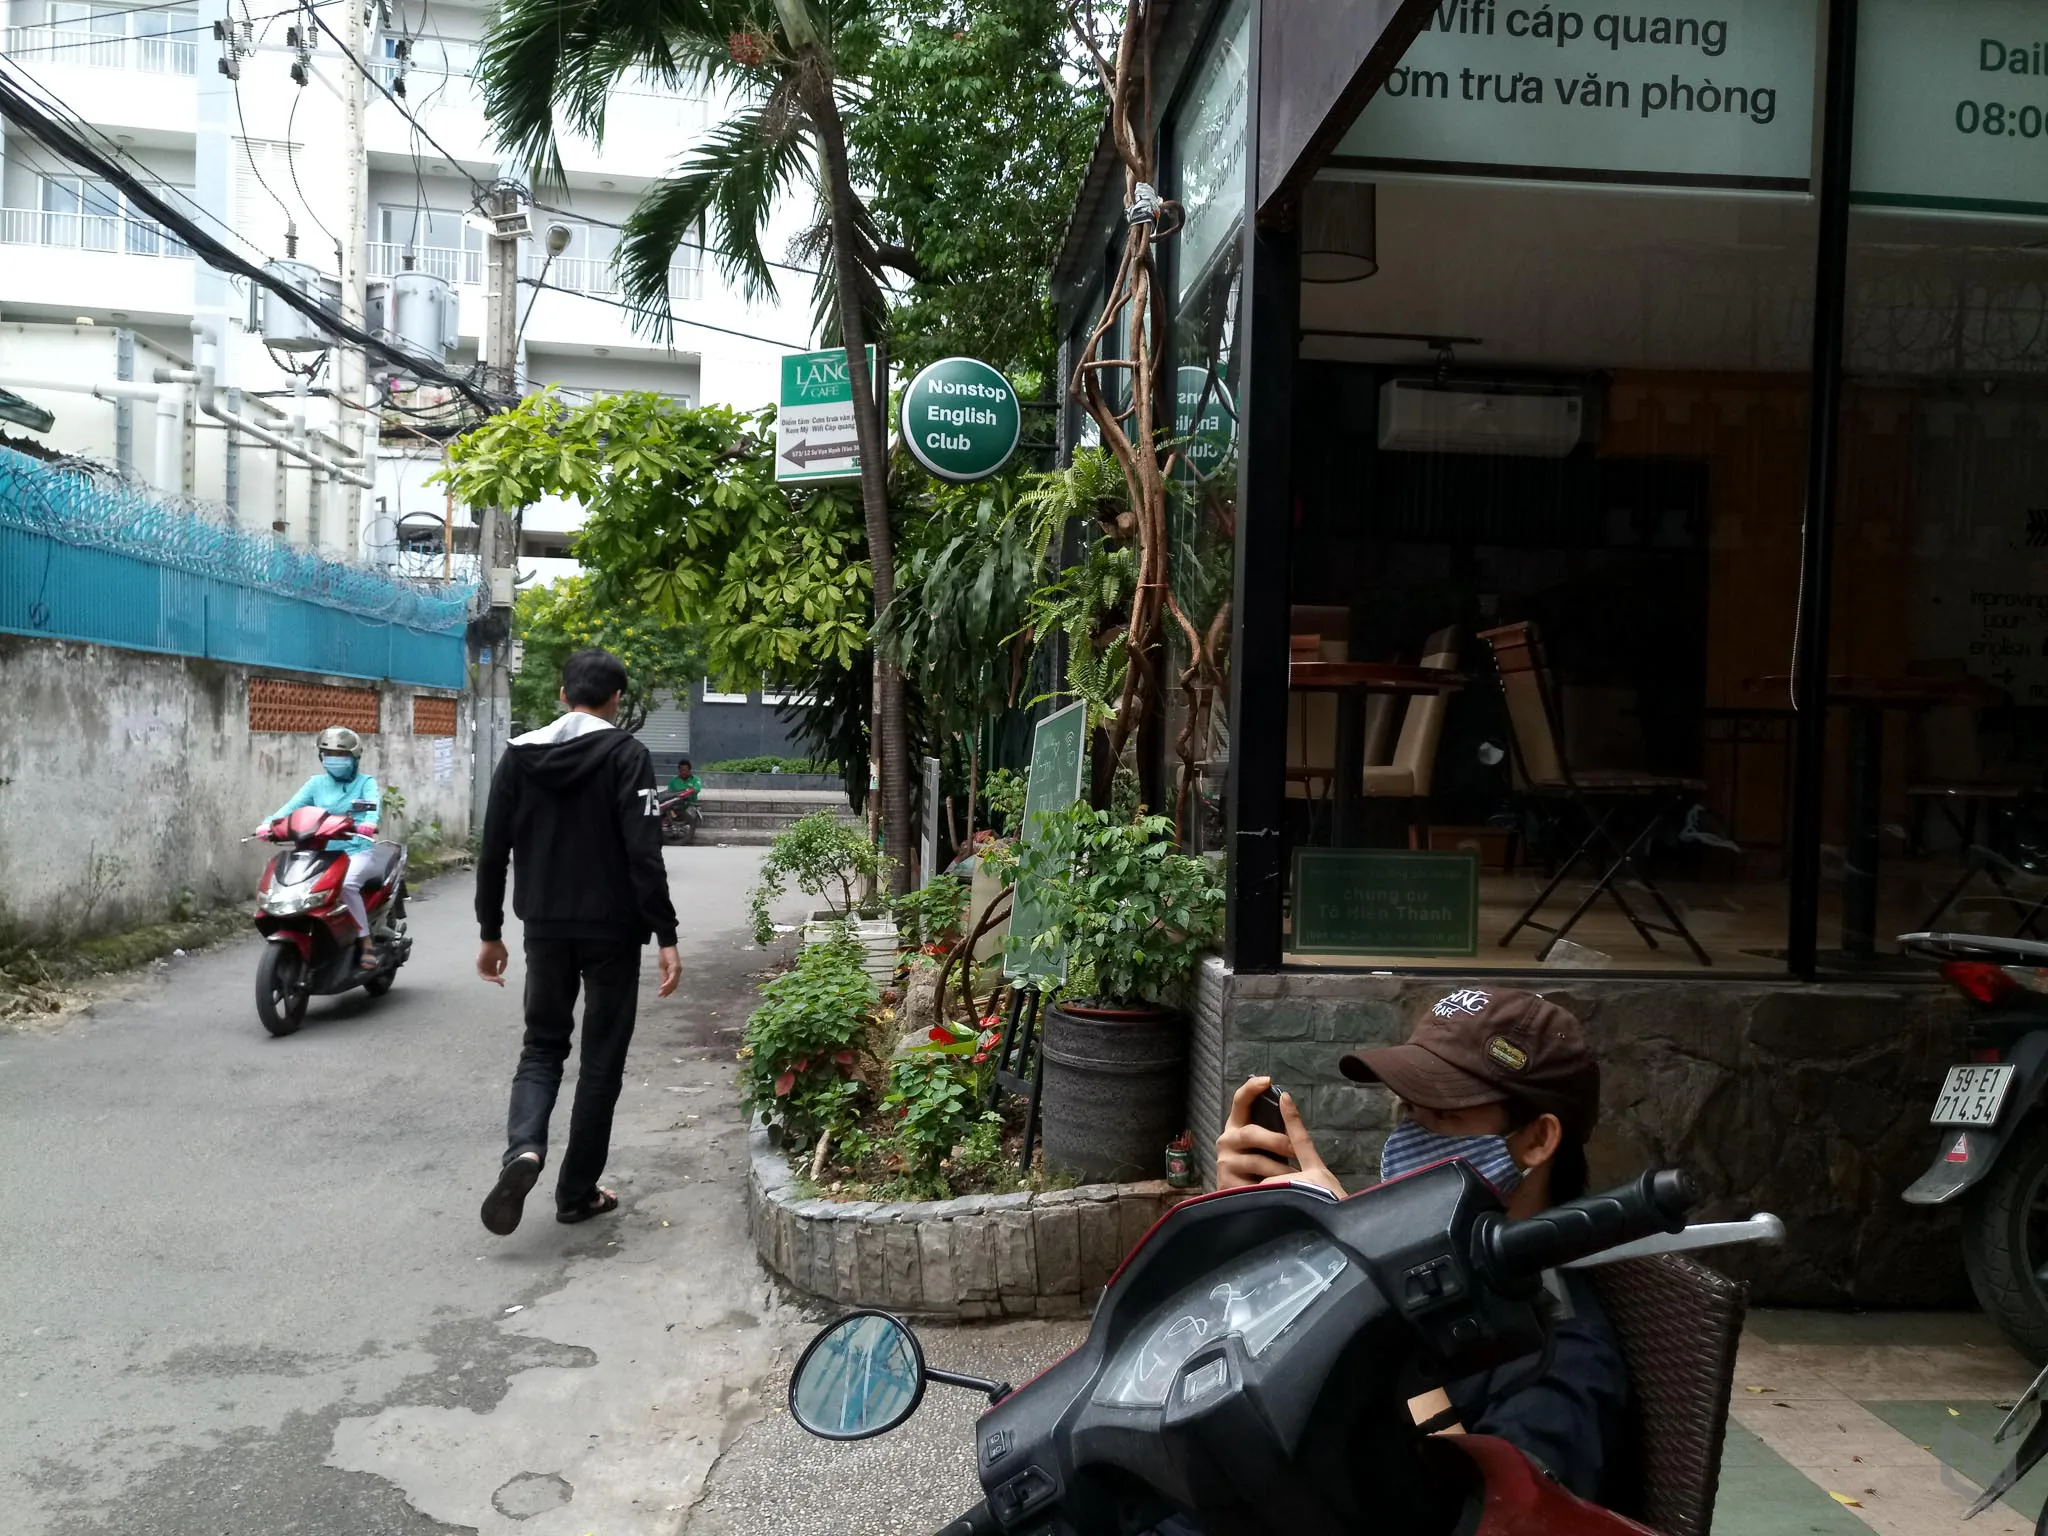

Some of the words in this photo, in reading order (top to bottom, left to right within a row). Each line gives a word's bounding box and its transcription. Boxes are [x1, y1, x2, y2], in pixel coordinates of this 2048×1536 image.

[1506, 3, 1583, 47] cáp
[1593, 12, 1727, 56] quang
[1980, 38, 2048, 76] Dail
[1384, 66, 1449, 98] ơm
[1459, 67, 1543, 104] trưa
[1554, 72, 1629, 108] văn
[1641, 74, 1776, 124] phòng
[1955, 100, 2048, 138] 08:0
[928, 379, 1007, 403] Nonstop
[927, 405, 997, 426] English
[926, 433, 971, 451] Club
[1935, 1095, 1996, 1121] 714.54
